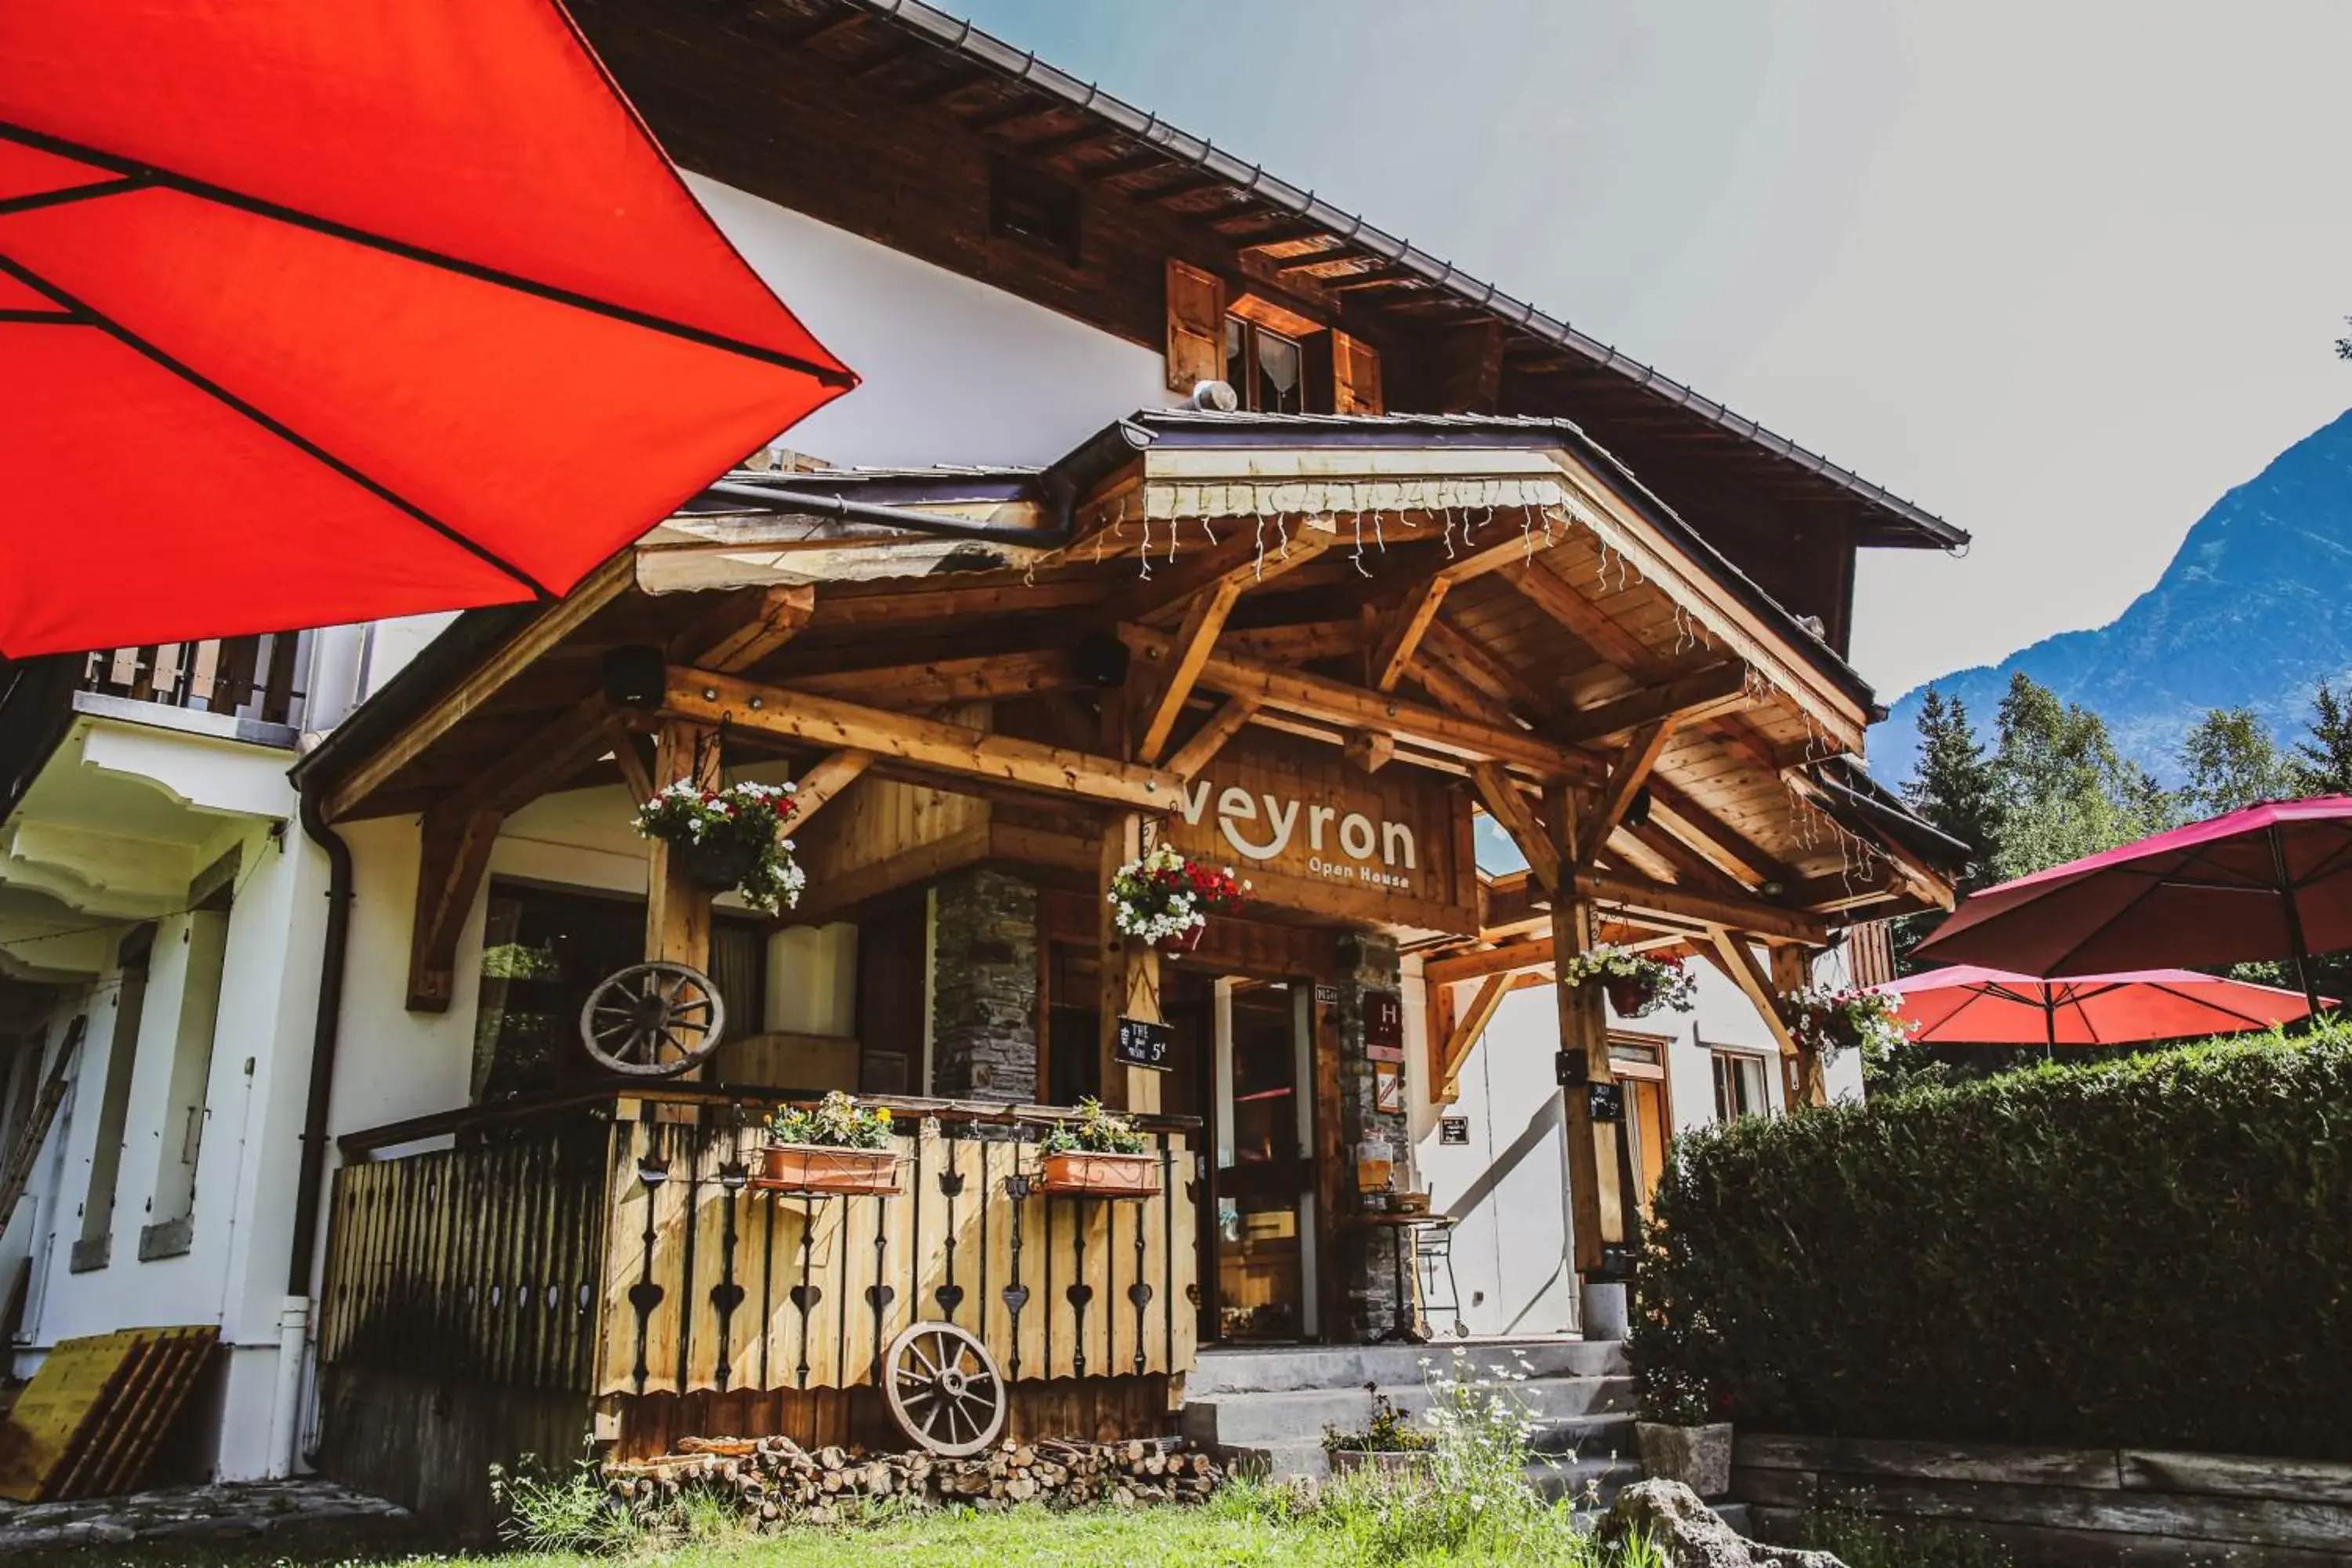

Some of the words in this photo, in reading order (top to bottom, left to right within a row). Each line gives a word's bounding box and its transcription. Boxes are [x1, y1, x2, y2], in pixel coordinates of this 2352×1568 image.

[1183, 779, 1417, 869] veyron
[1308, 856, 1353, 877] Open
[1360, 866, 1410, 888] House
[1382, 1003, 1396, 1024] H
